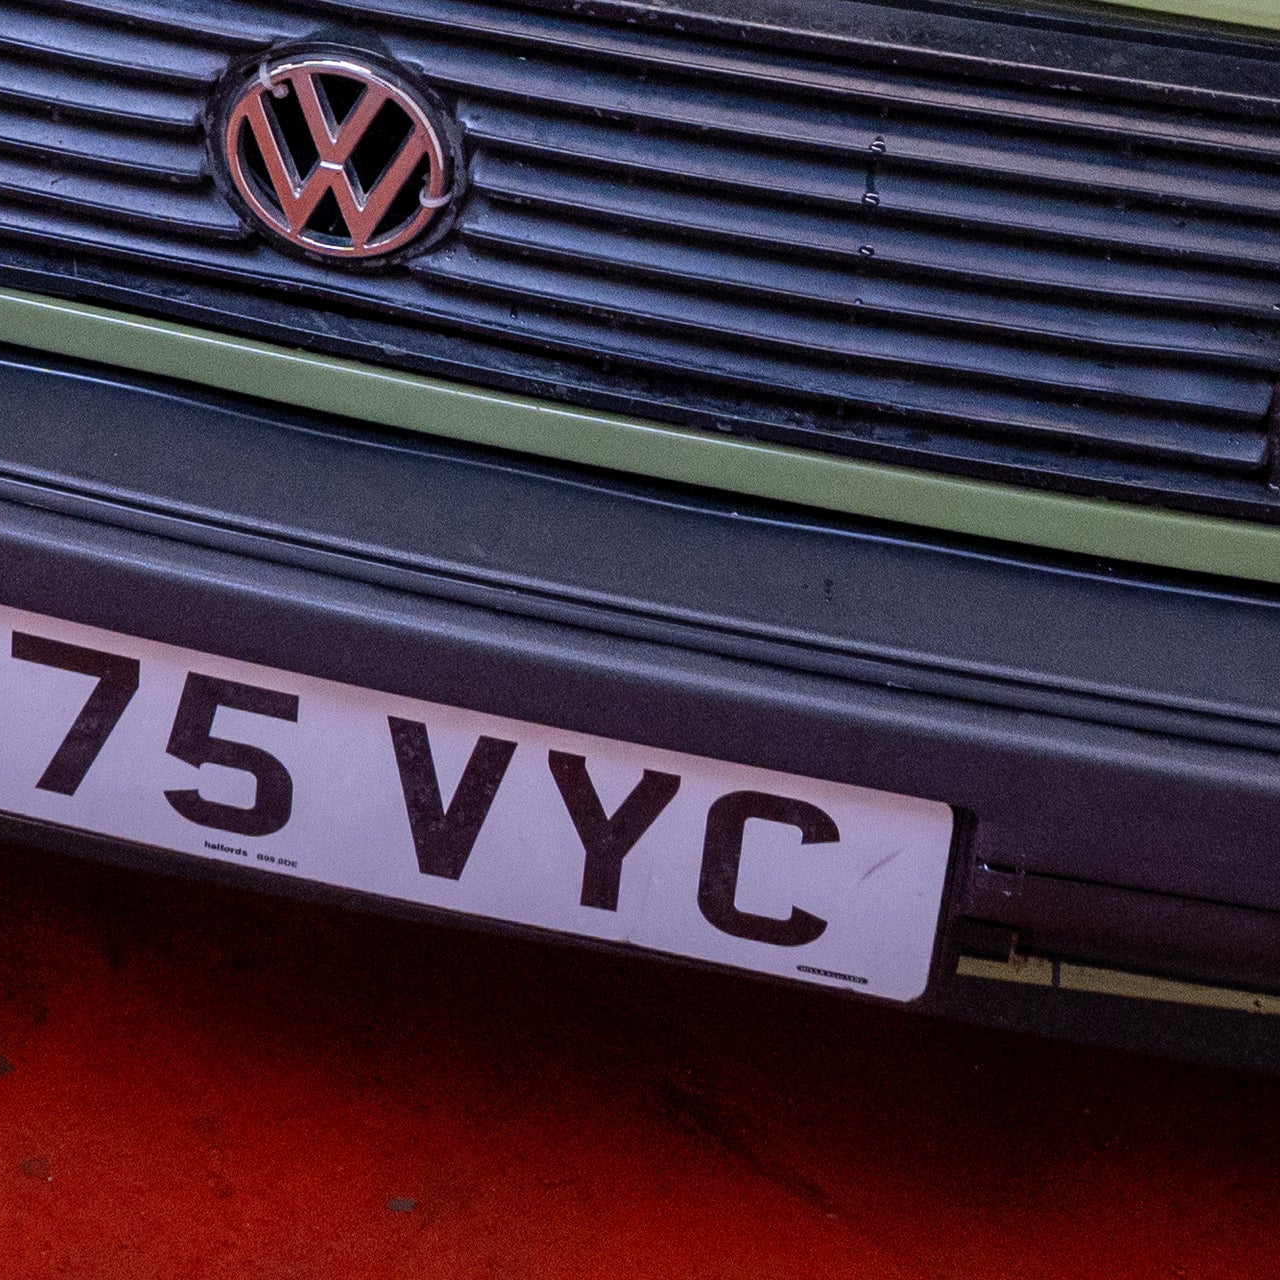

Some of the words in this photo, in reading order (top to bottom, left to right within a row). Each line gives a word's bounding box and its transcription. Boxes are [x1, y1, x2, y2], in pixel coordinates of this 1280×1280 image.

[226, 60, 444, 257] VW
[203, 840, 249, 857] halfords
[387, 715, 841, 948] VYC
